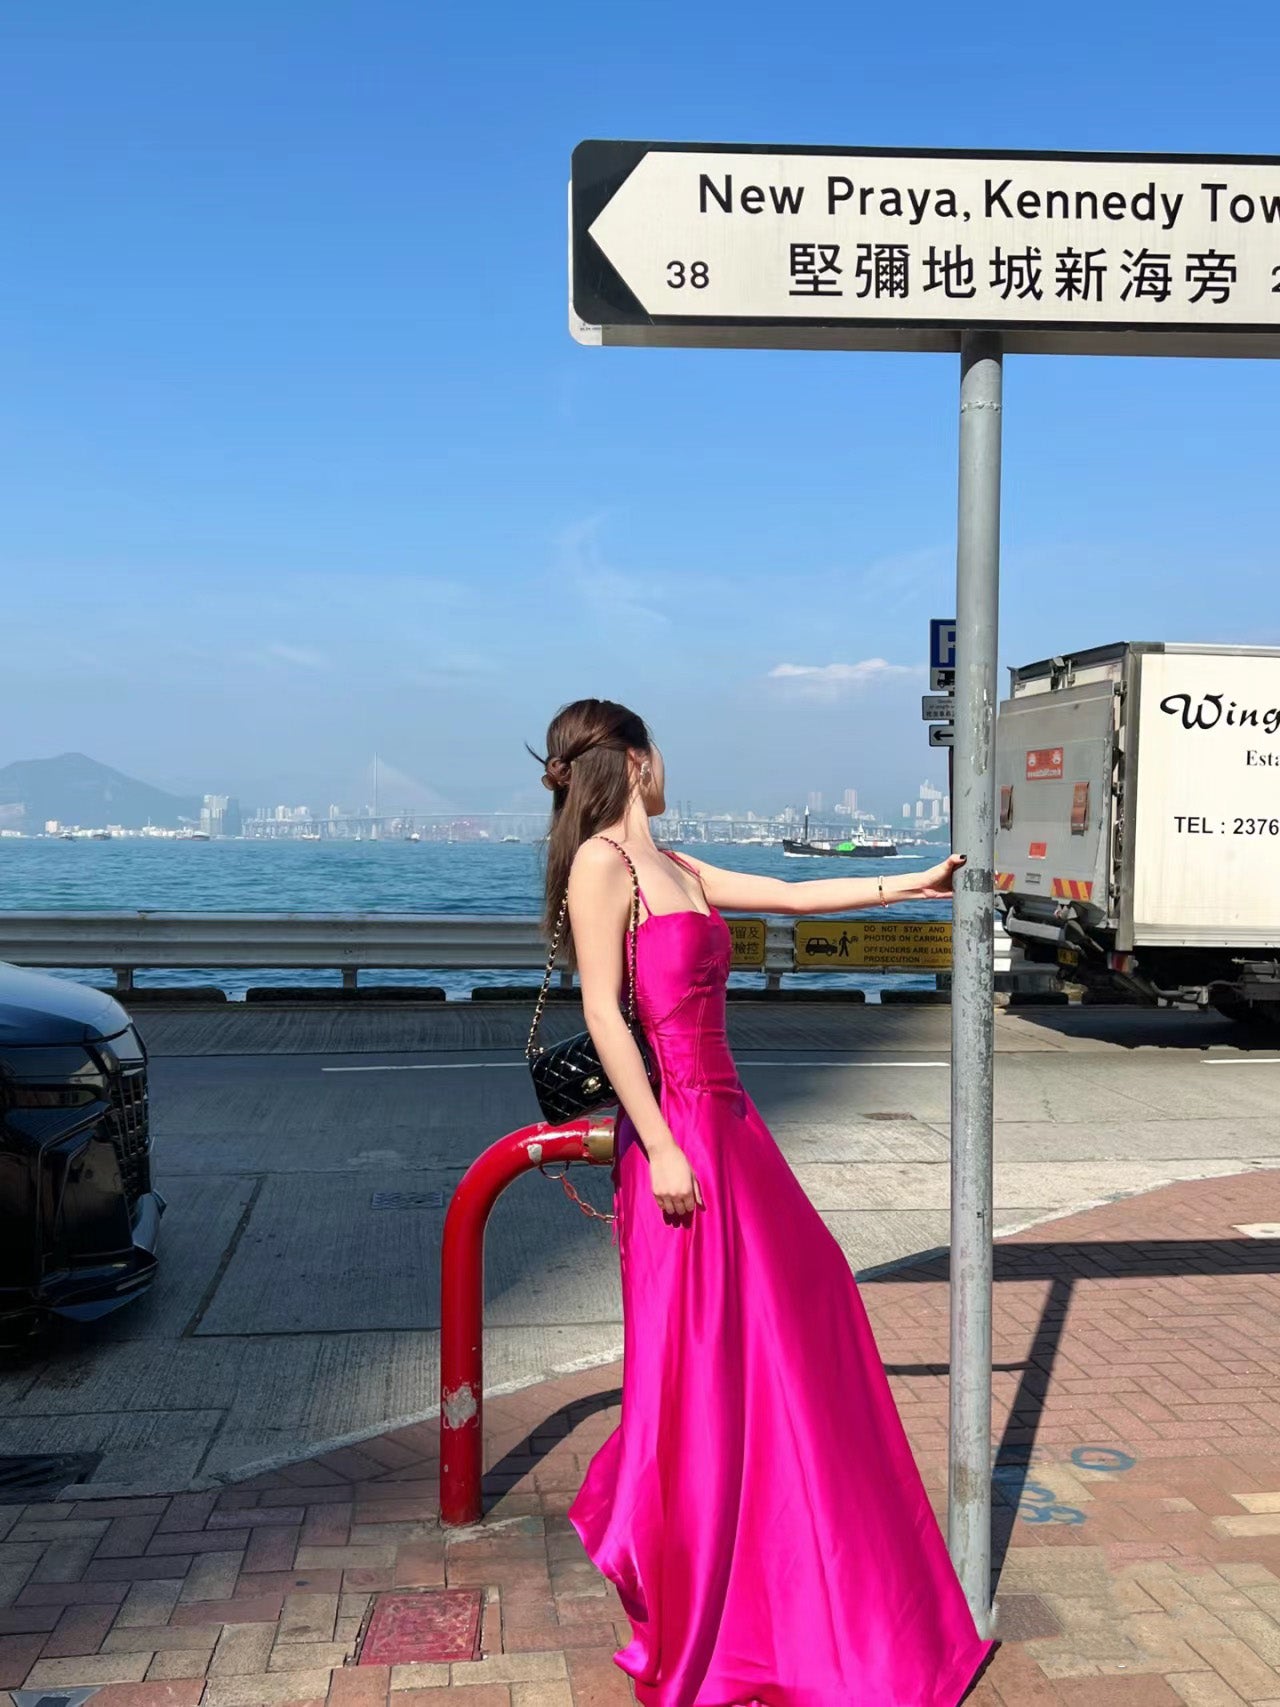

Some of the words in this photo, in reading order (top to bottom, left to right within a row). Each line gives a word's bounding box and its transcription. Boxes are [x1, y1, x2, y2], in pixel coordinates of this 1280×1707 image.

[700, 174, 804, 213] New
[827, 177, 971, 223] Praya,
[985, 180, 1183, 229] Kennedy
[666, 261, 711, 289] 38
[788, 242, 1238, 305] 堅彌地城新海旁
[1160, 693, 1280, 735] Wing
[1174, 816, 1213, 834] TEL
[1233, 818, 1279, 836] 2376
[928, 926, 945, 934] AND
[864, 946, 911, 954] OFFENDERS
[912, 946, 928, 954] ARE
